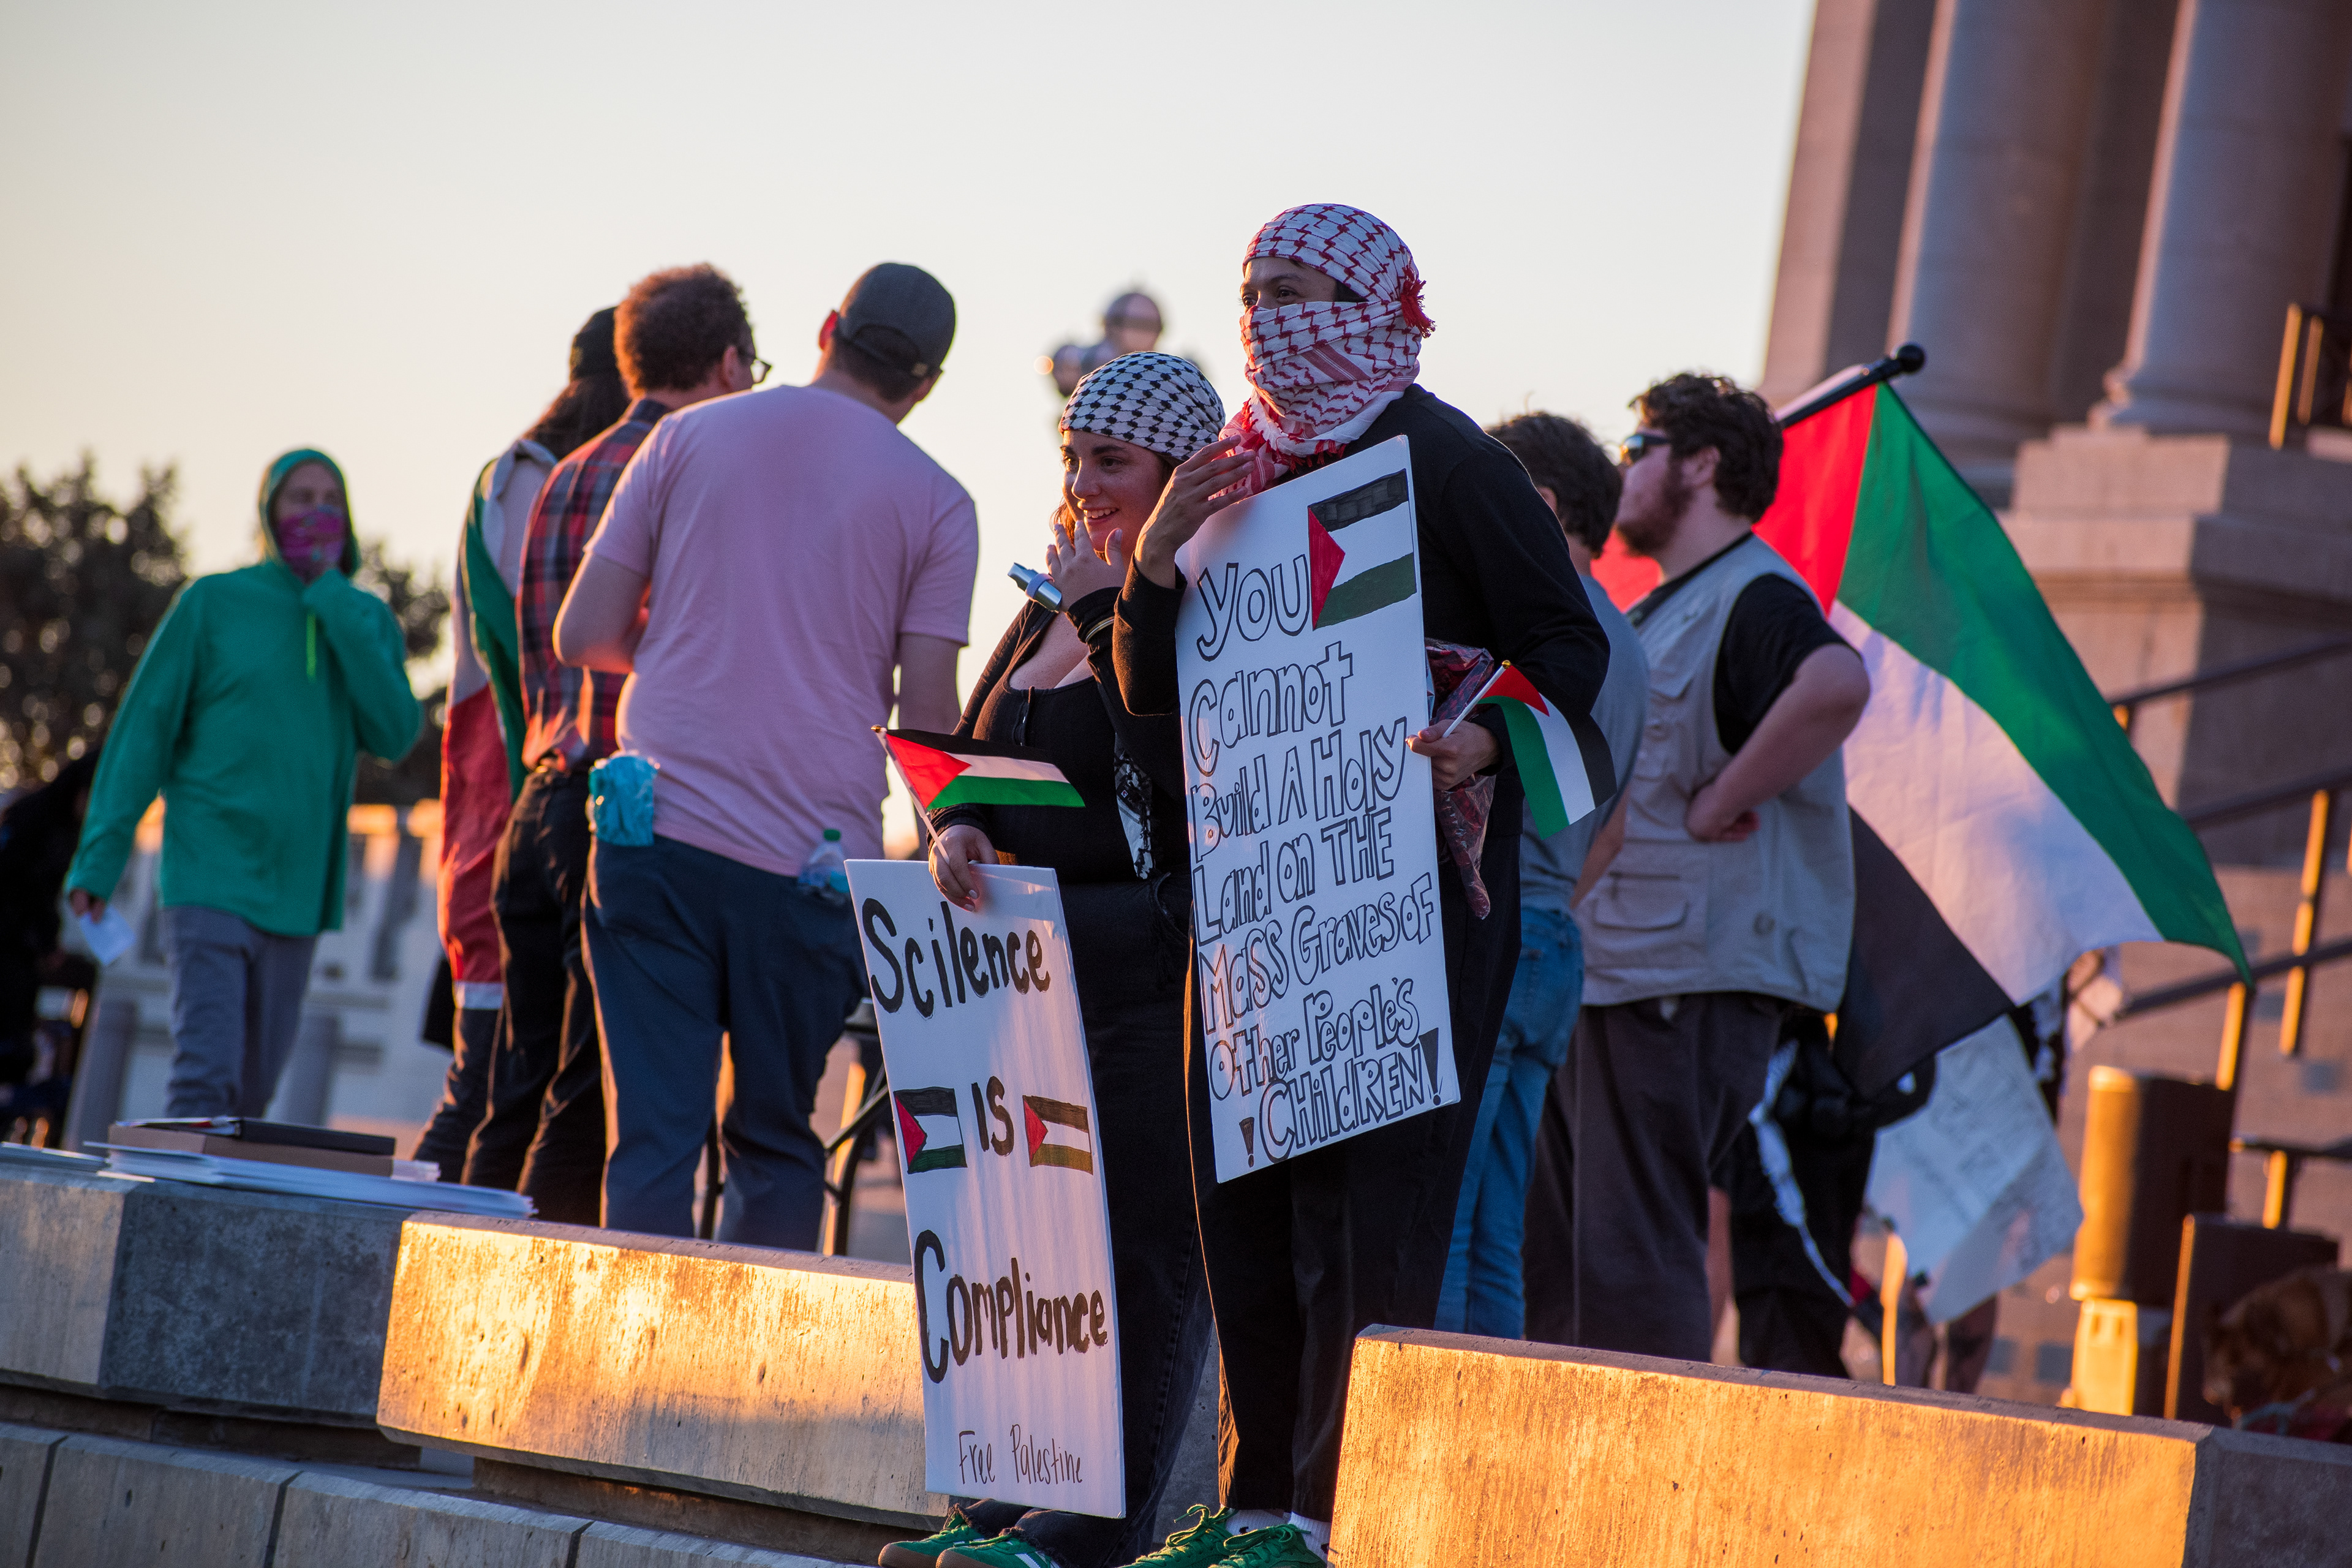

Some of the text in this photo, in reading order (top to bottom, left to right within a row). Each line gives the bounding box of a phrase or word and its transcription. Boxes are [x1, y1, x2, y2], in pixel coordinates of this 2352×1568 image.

[1188, 640, 1354, 777] Cannot
[1190, 716, 1408, 864] Build A Holy
[1193, 806, 1395, 946] Land on THE
[861, 897, 1052, 1020] Scilence
[971, 1075, 1015, 1157] IS
[1209, 1023, 1300, 1101] Other
[914, 1229, 1109, 1384] Compliance
[958, 1423, 1083, 1485] Free Palestine
